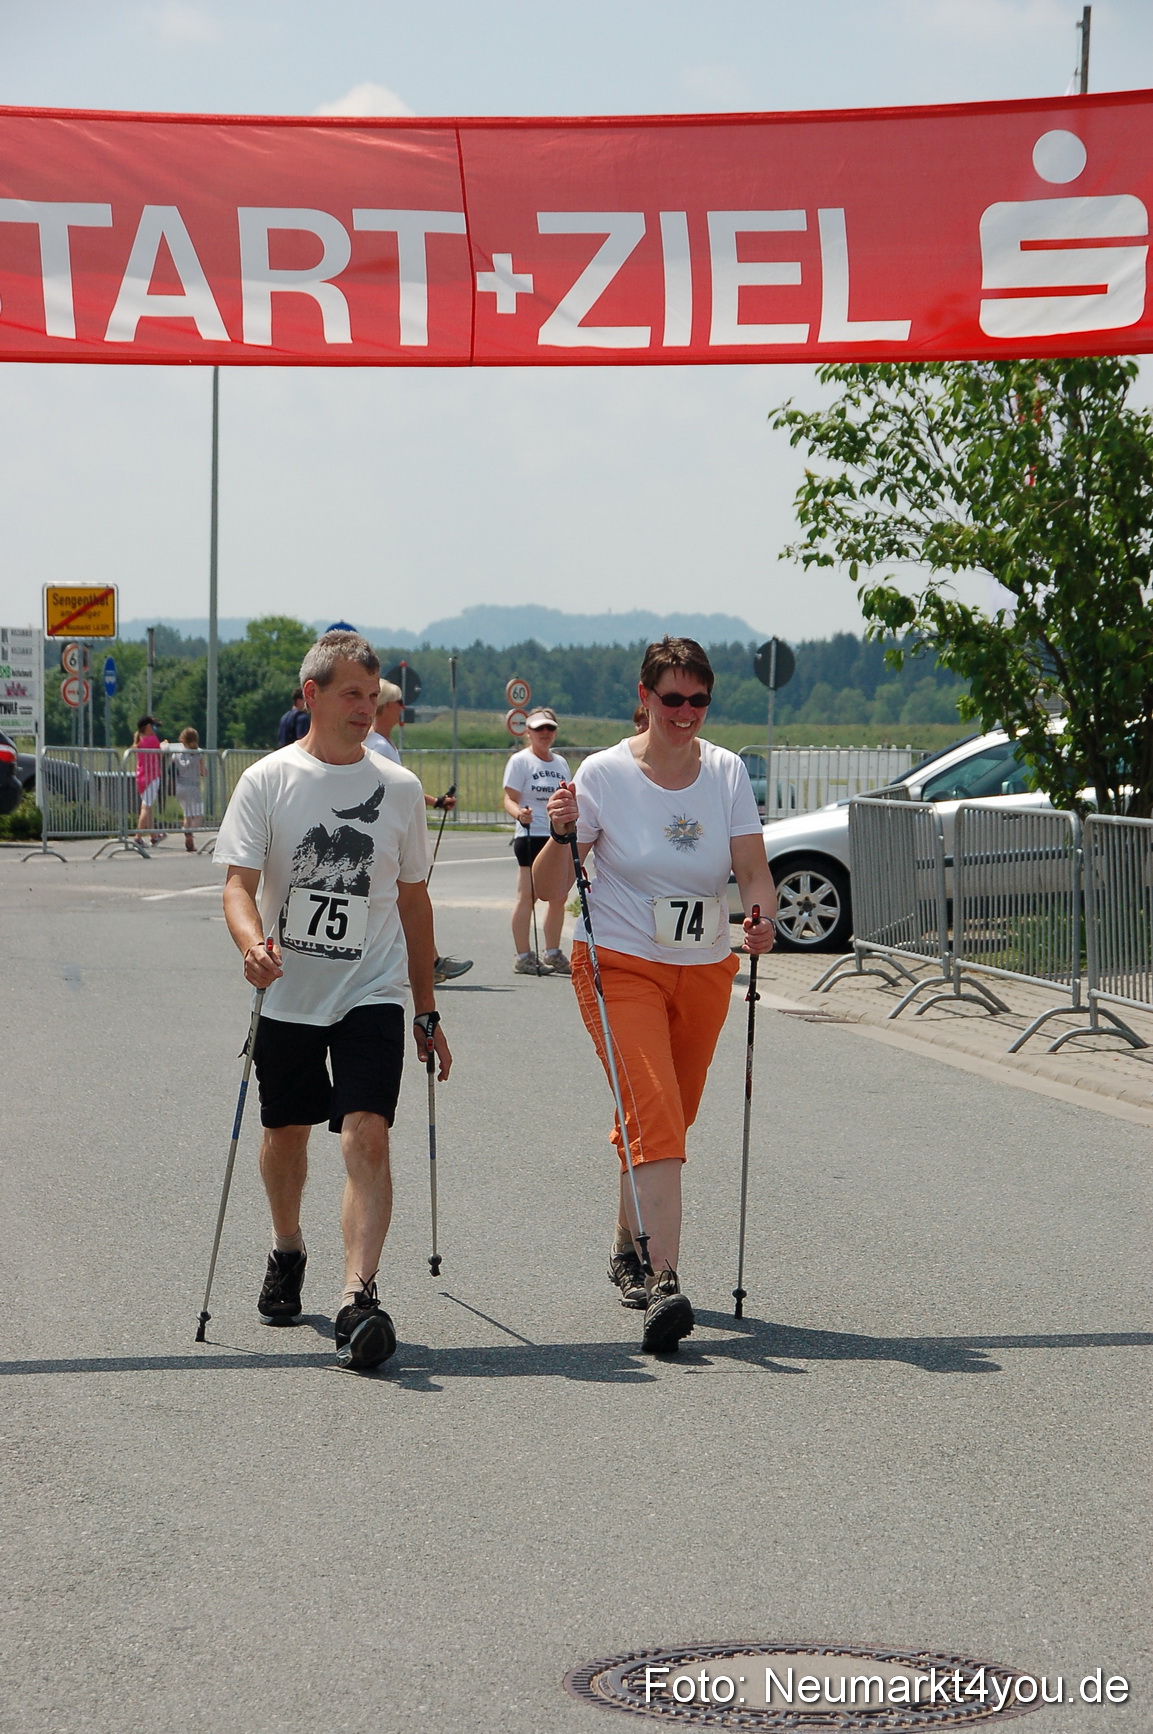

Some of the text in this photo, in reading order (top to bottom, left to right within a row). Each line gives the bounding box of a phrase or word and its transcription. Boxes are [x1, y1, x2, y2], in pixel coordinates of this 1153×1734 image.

[512, 687, 525, 699] 60
[307, 893, 349, 941] 75
[670, 901, 704, 941] 74
